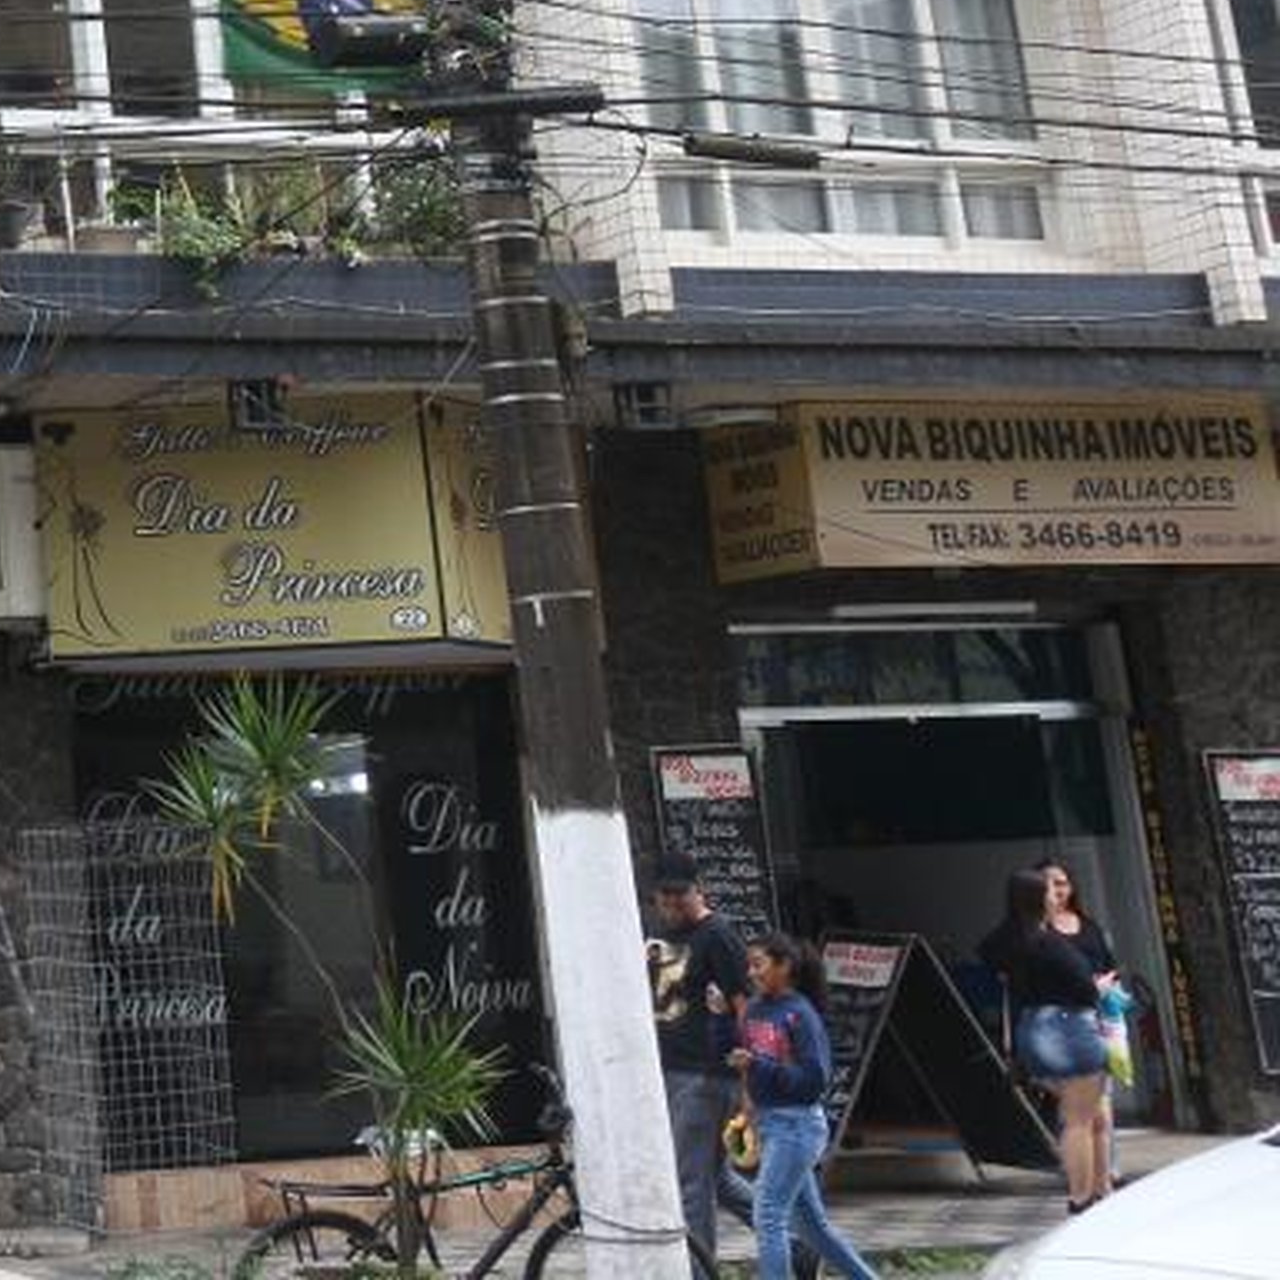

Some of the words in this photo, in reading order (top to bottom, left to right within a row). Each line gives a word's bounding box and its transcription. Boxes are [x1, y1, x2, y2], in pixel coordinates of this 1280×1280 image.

[815, 416, 922, 462] NOVA
[925, 416, 1109, 465] BIQUINHA
[1111, 409, 1258, 459] IMÓVEIS
[134, 474, 230, 536] Dia
[860, 478, 973, 503] VENDAS
[1012, 478, 1030, 502] E
[1017, 521, 1183, 549] 3466-8419
[219, 540, 428, 607] Princesa
[402, 780, 503, 855] Dia
[434, 866, 488, 927] da
[402, 941, 533, 1014] Noiva
